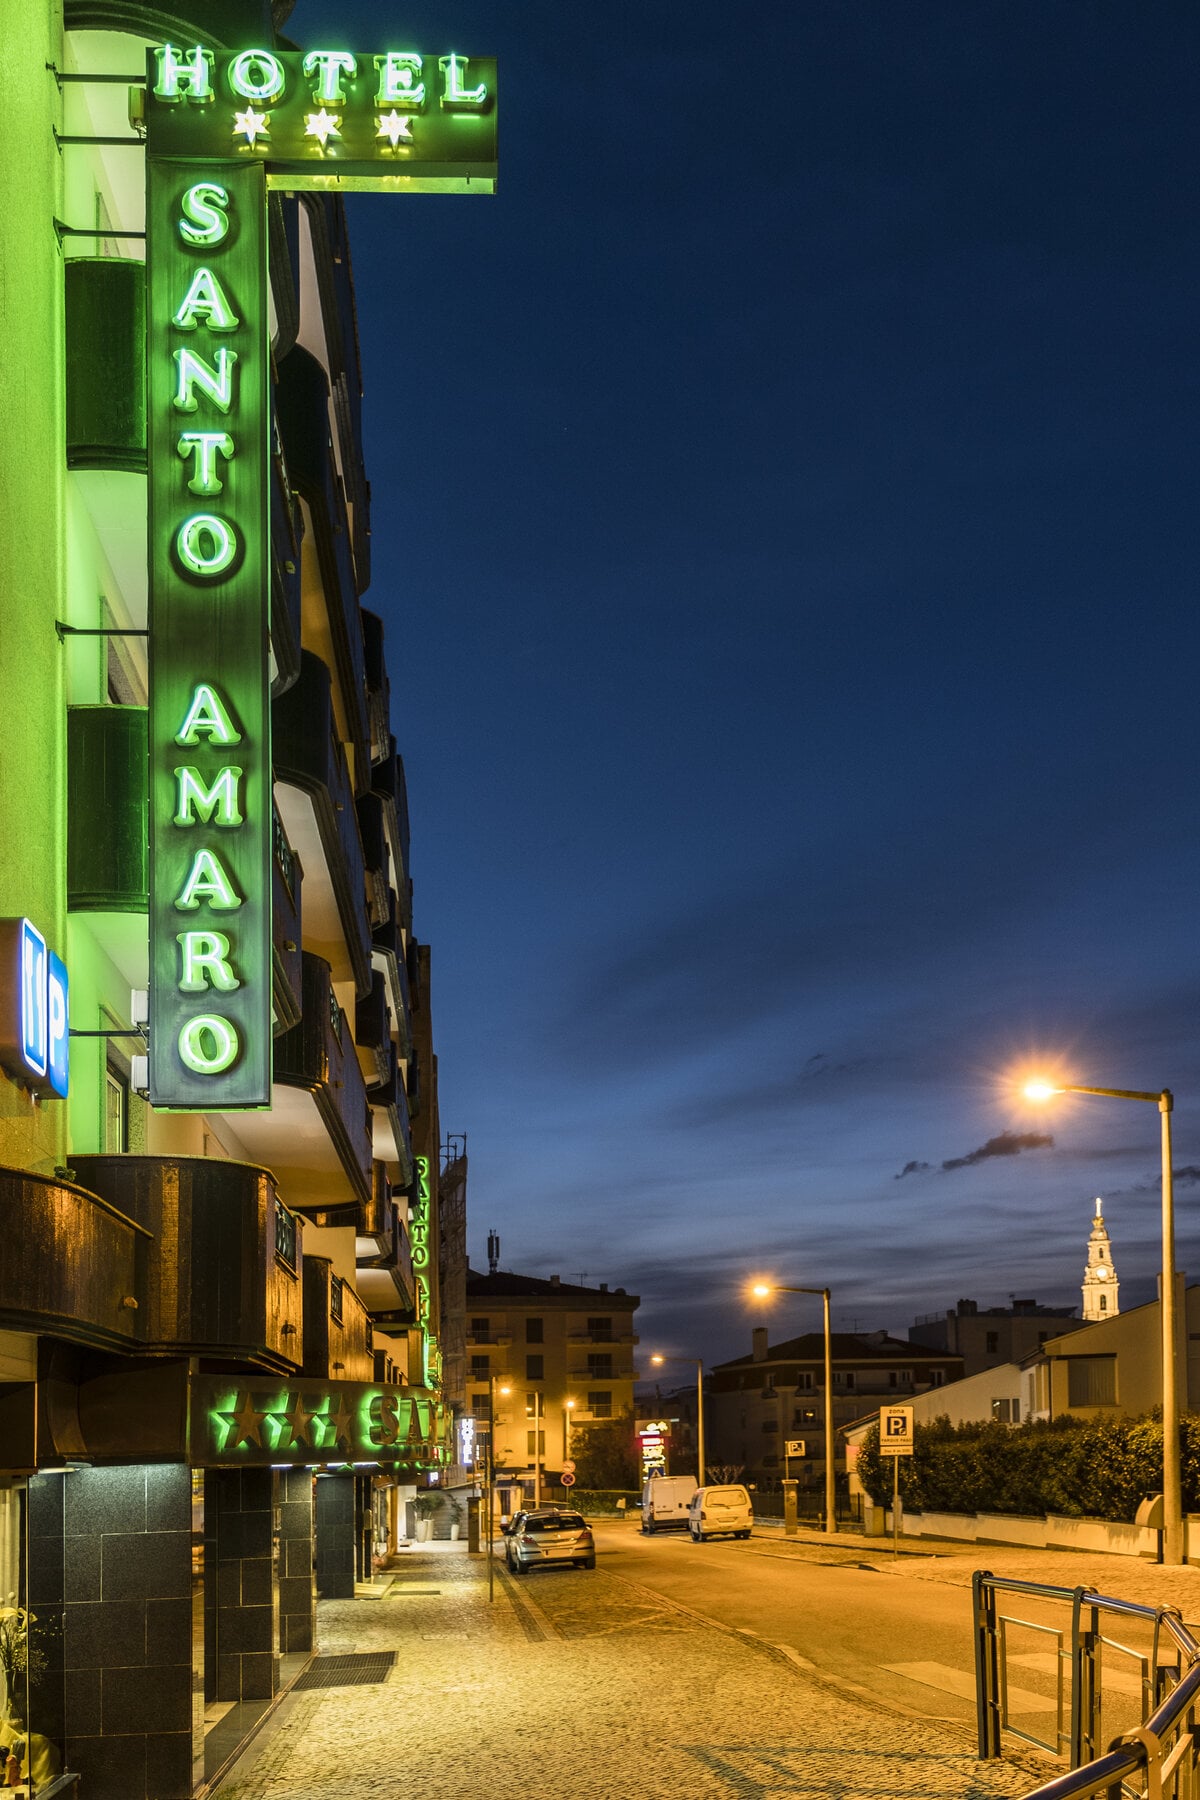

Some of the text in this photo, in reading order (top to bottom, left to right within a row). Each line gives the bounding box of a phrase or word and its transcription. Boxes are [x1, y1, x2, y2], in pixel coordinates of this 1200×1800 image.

[153, 44, 487, 108] HOTEL
[172, 183, 243, 1075] SANTO AMARO
[49, 971, 66, 1066] P
[890, 1417, 903, 1434] P
